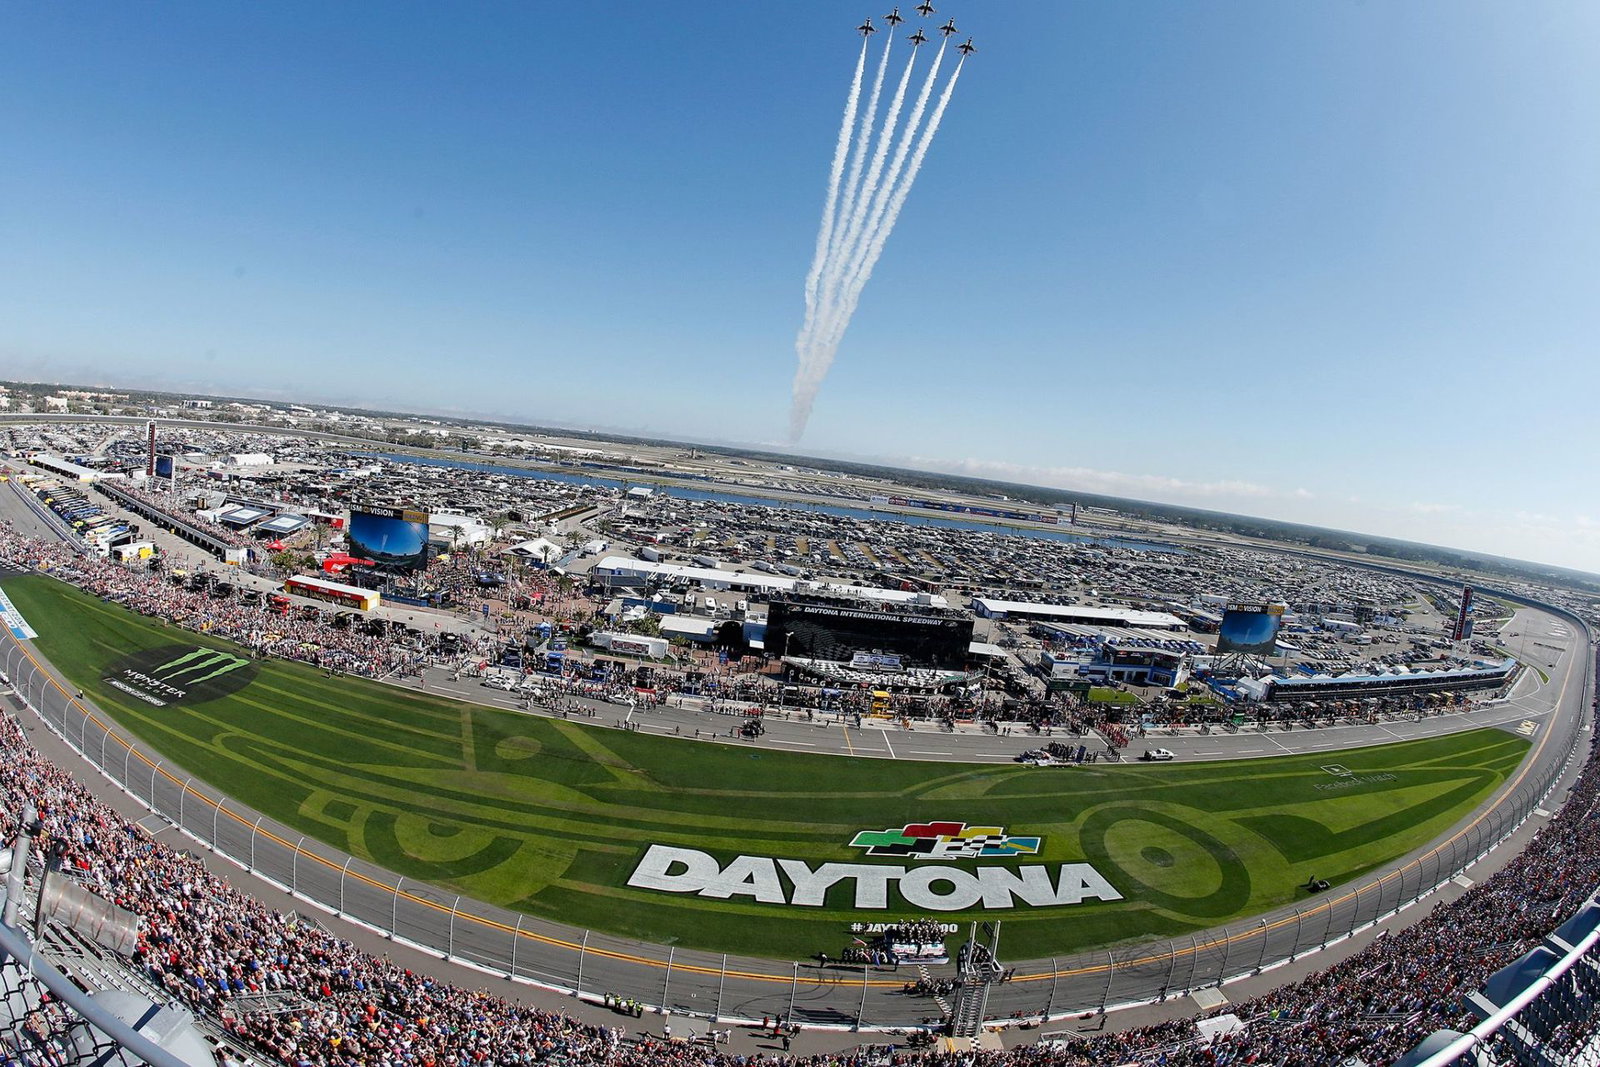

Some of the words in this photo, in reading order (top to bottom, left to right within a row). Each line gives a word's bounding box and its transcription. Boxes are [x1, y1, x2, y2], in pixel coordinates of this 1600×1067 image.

[370, 507, 394, 517] VISION
[804, 606, 839, 616] DAYTONA
[840, 610, 901, 622] INTERNATIONAL
[902, 616, 943, 626] SPEEDWAY
[123, 668, 187, 698] MONSTER
[627, 844, 1124, 909] DAYTONA
